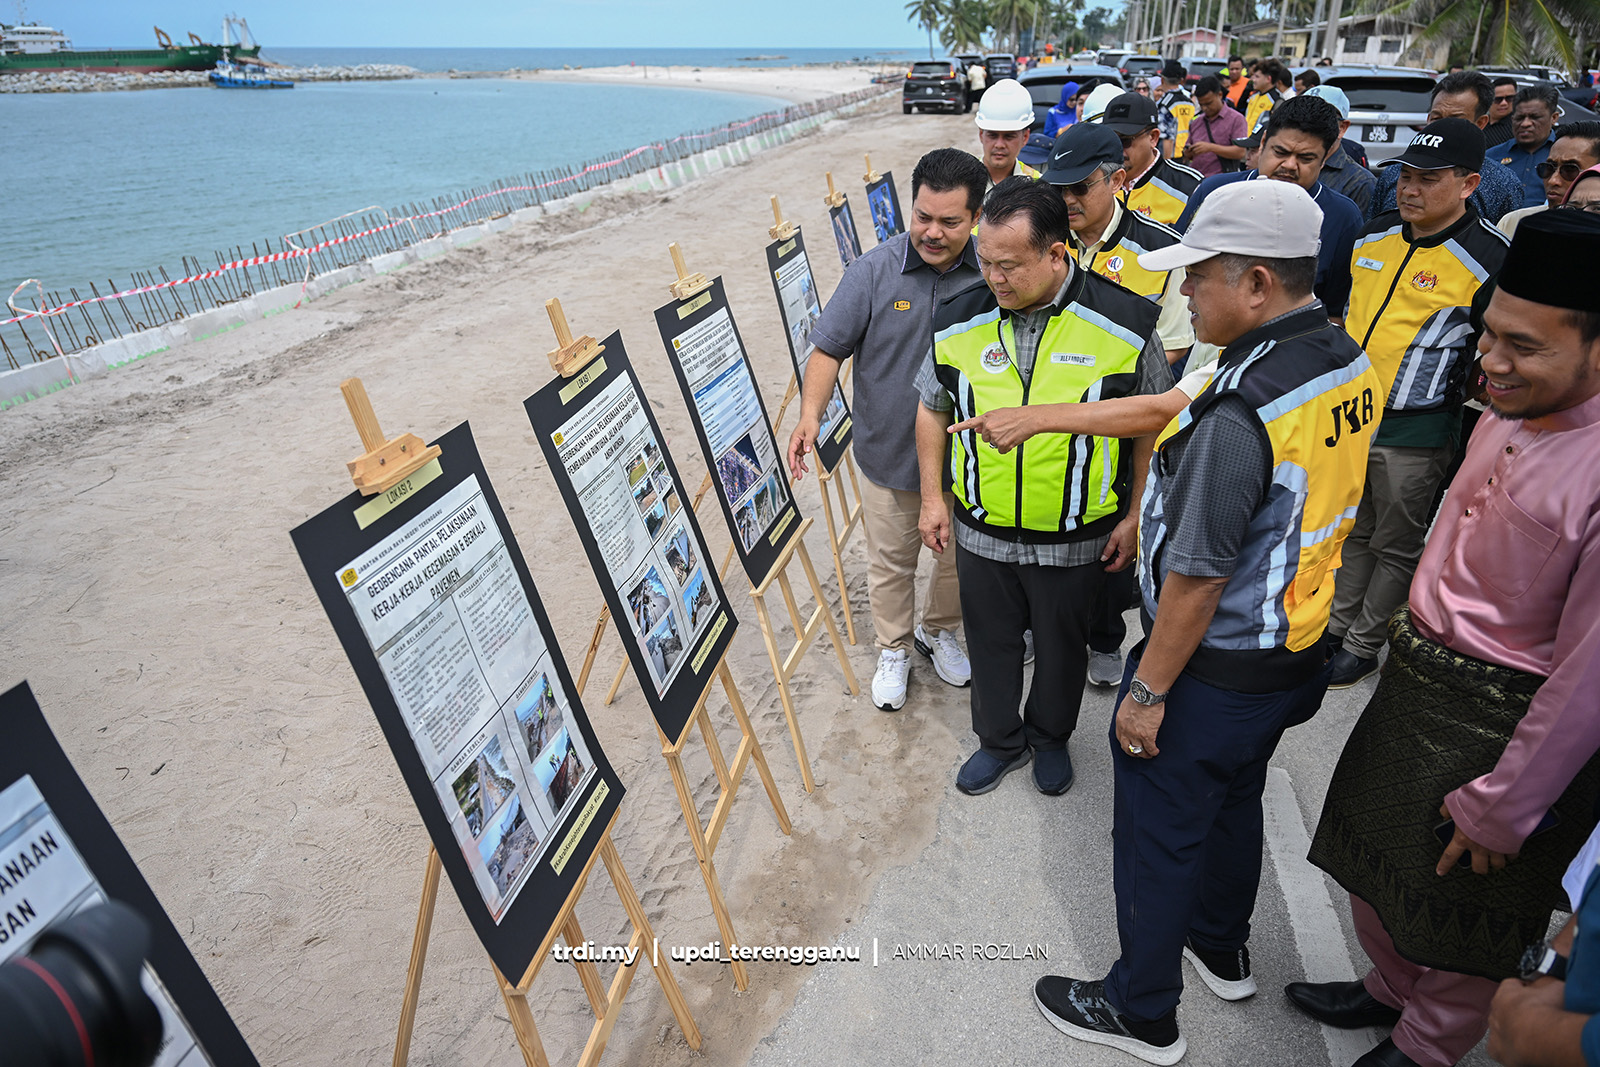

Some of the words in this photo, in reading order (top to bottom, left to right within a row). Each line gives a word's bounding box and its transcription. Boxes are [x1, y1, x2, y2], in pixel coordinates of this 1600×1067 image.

[1325, 388, 1373, 448] JKR
[386, 482, 408, 504] LOKASI
[406, 479, 413, 490] 2
[367, 556, 416, 598] GEOBENCANA
[413, 538, 440, 562] PANTAI:
[436, 504, 477, 543] PELAKSANAAN
[371, 574, 424, 621] KERJA-KERJA
[422, 543, 460, 581] KECEMASAN
[458, 540, 465, 551] &
[462, 520, 486, 547] BERKALA
[430, 567, 460, 600] PAVEMEN
[0, 830, 59, 896] ANAAN
